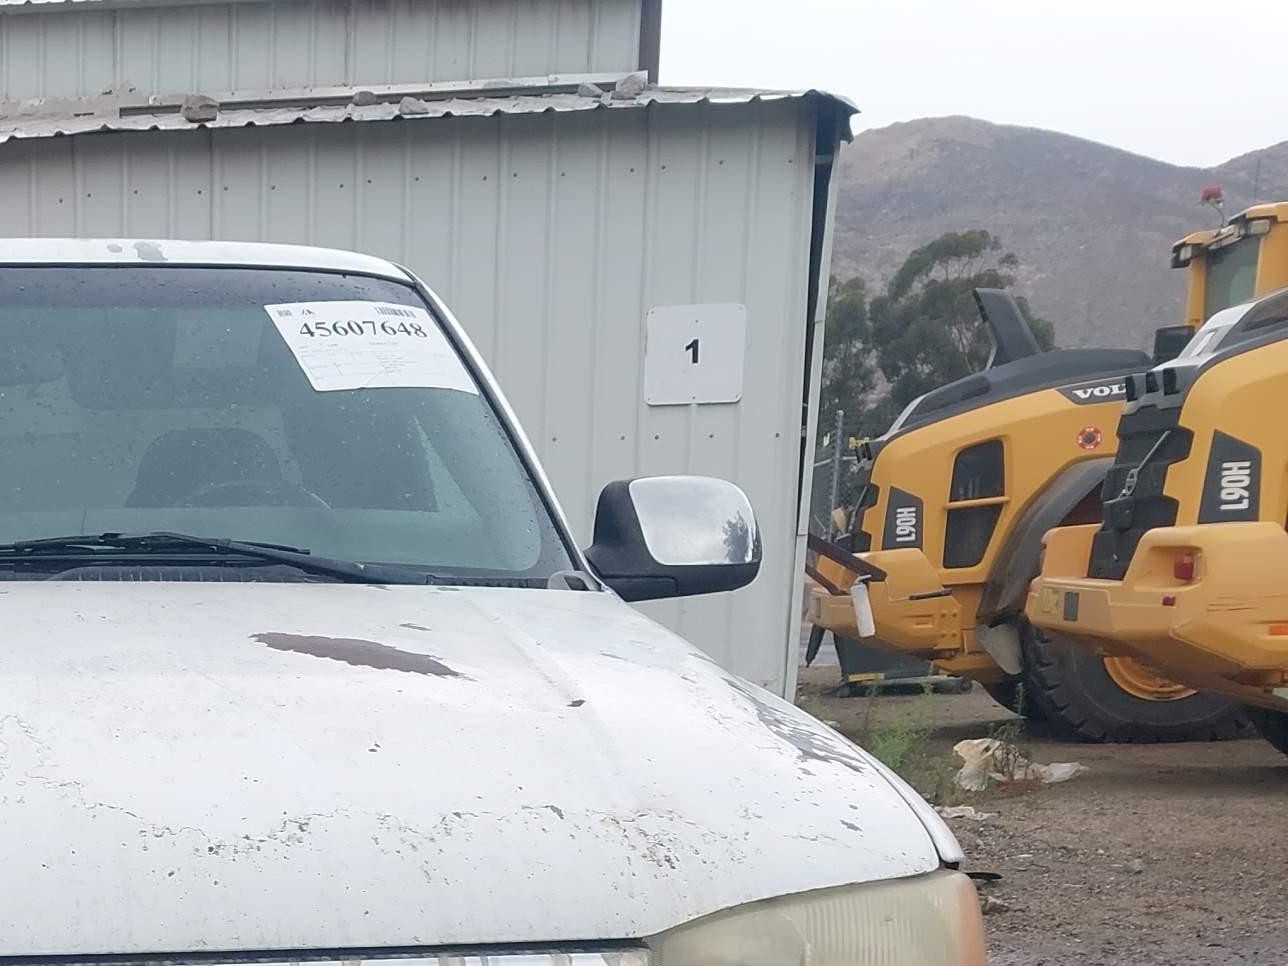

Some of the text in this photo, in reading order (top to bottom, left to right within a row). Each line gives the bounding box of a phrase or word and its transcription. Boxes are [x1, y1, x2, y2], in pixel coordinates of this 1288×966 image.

[299, 320, 428, 338] 45607648
[685, 338, 699, 364] 1
[1219, 461, 1251, 510] L90H
[895, 506, 917, 542] L90H
